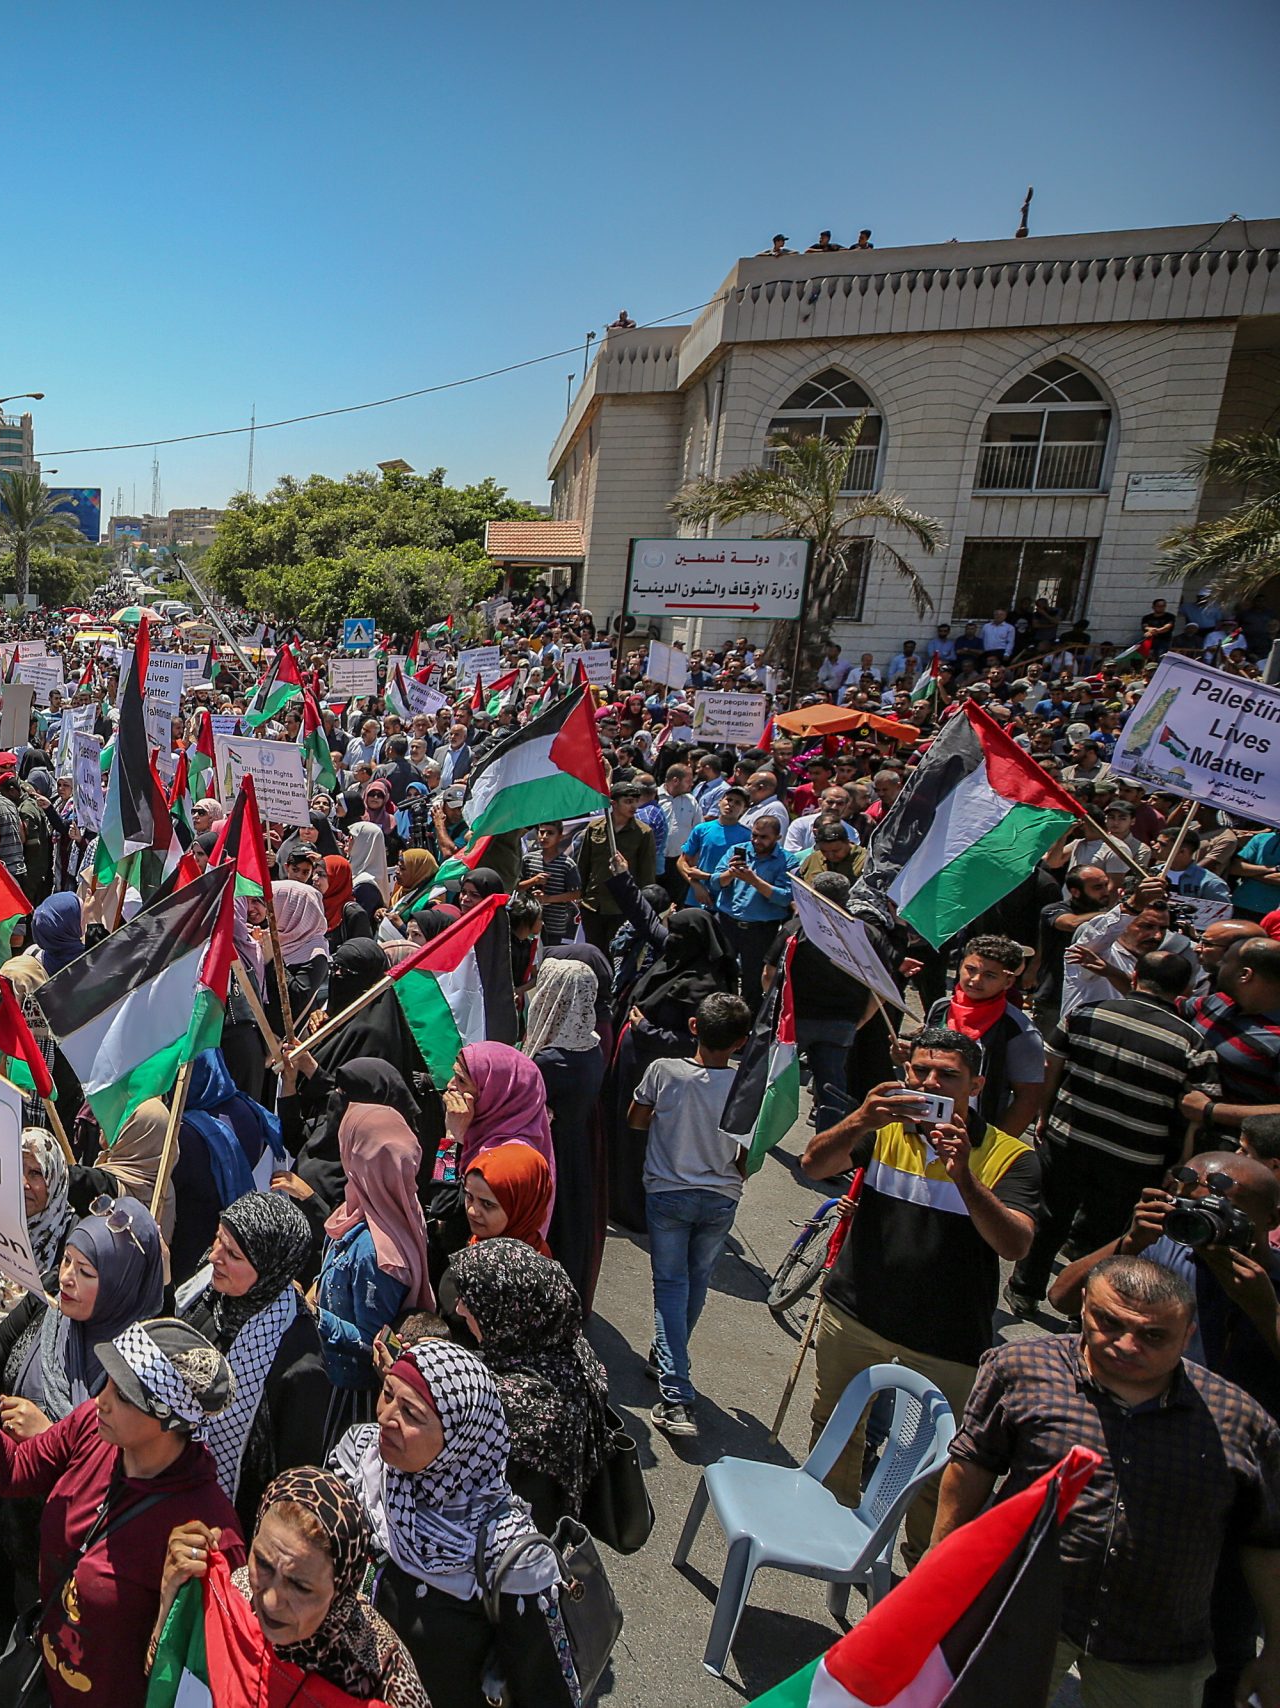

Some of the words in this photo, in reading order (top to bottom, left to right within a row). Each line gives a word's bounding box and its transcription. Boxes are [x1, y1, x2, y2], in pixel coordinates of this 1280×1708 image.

[675, 550, 726, 566] فلسطين
[730, 552, 770, 567] دولة
[632, 579, 681, 598] الدينية
[728, 580, 769, 599] الأوقاف
[771, 582, 800, 600] وزارة
[149, 659, 184, 670] estinian
[146, 673, 169, 683] Lives
[410, 694, 427, 706] Lives
[723, 699, 748, 707] people
[1191, 677, 1280, 723] Palestin
[1208, 718, 1271, 754] Lives
[251, 767, 272, 775] Human
[273, 770, 293, 779] Rights
[1189, 746, 1265, 785] Matter
[276, 788, 290, 797] West
